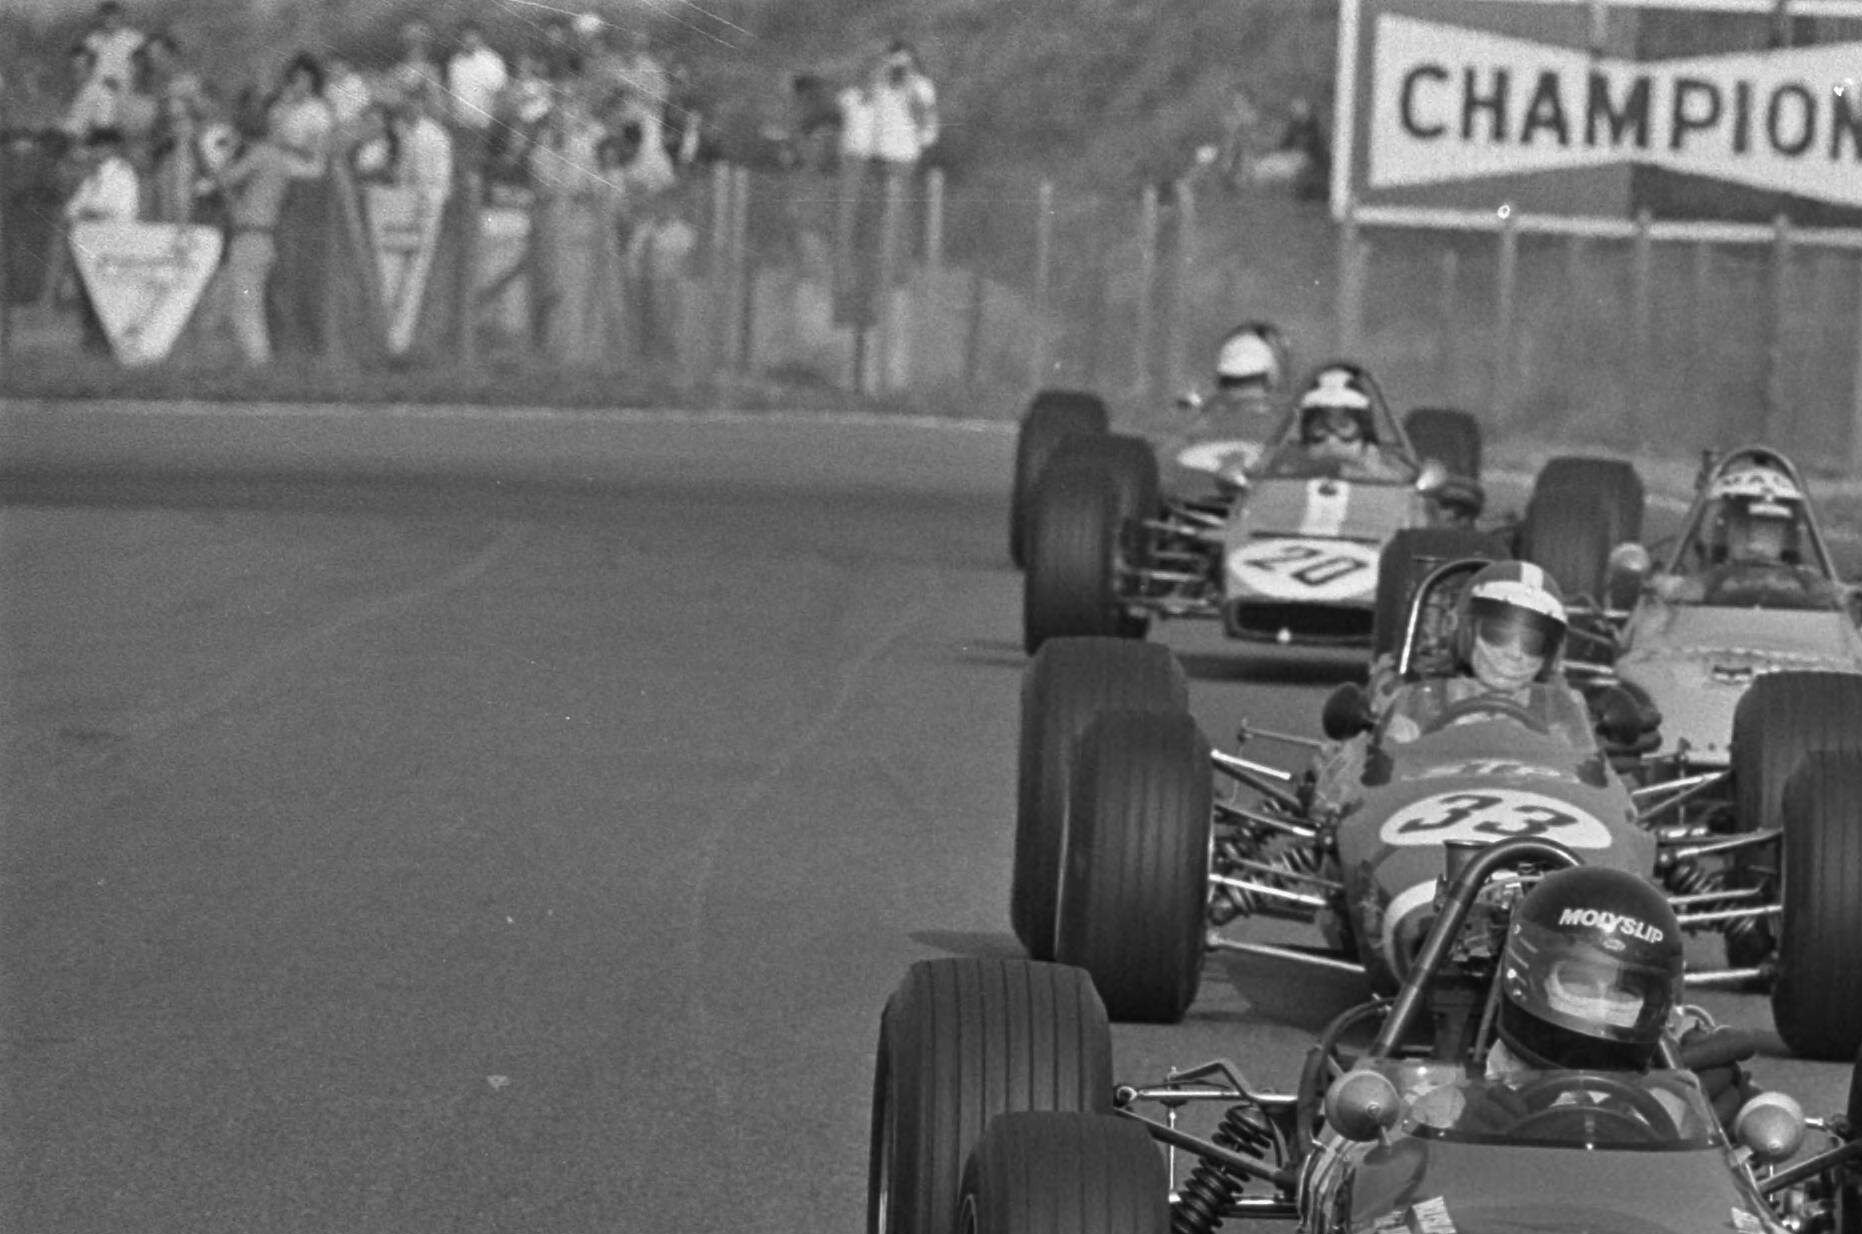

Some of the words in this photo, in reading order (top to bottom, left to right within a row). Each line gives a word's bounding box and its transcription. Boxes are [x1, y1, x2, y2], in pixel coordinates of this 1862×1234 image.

[1244, 546, 1367, 586] 20
[1398, 794, 1579, 837] 33
[1559, 908, 1664, 944] MOLYSLIP
